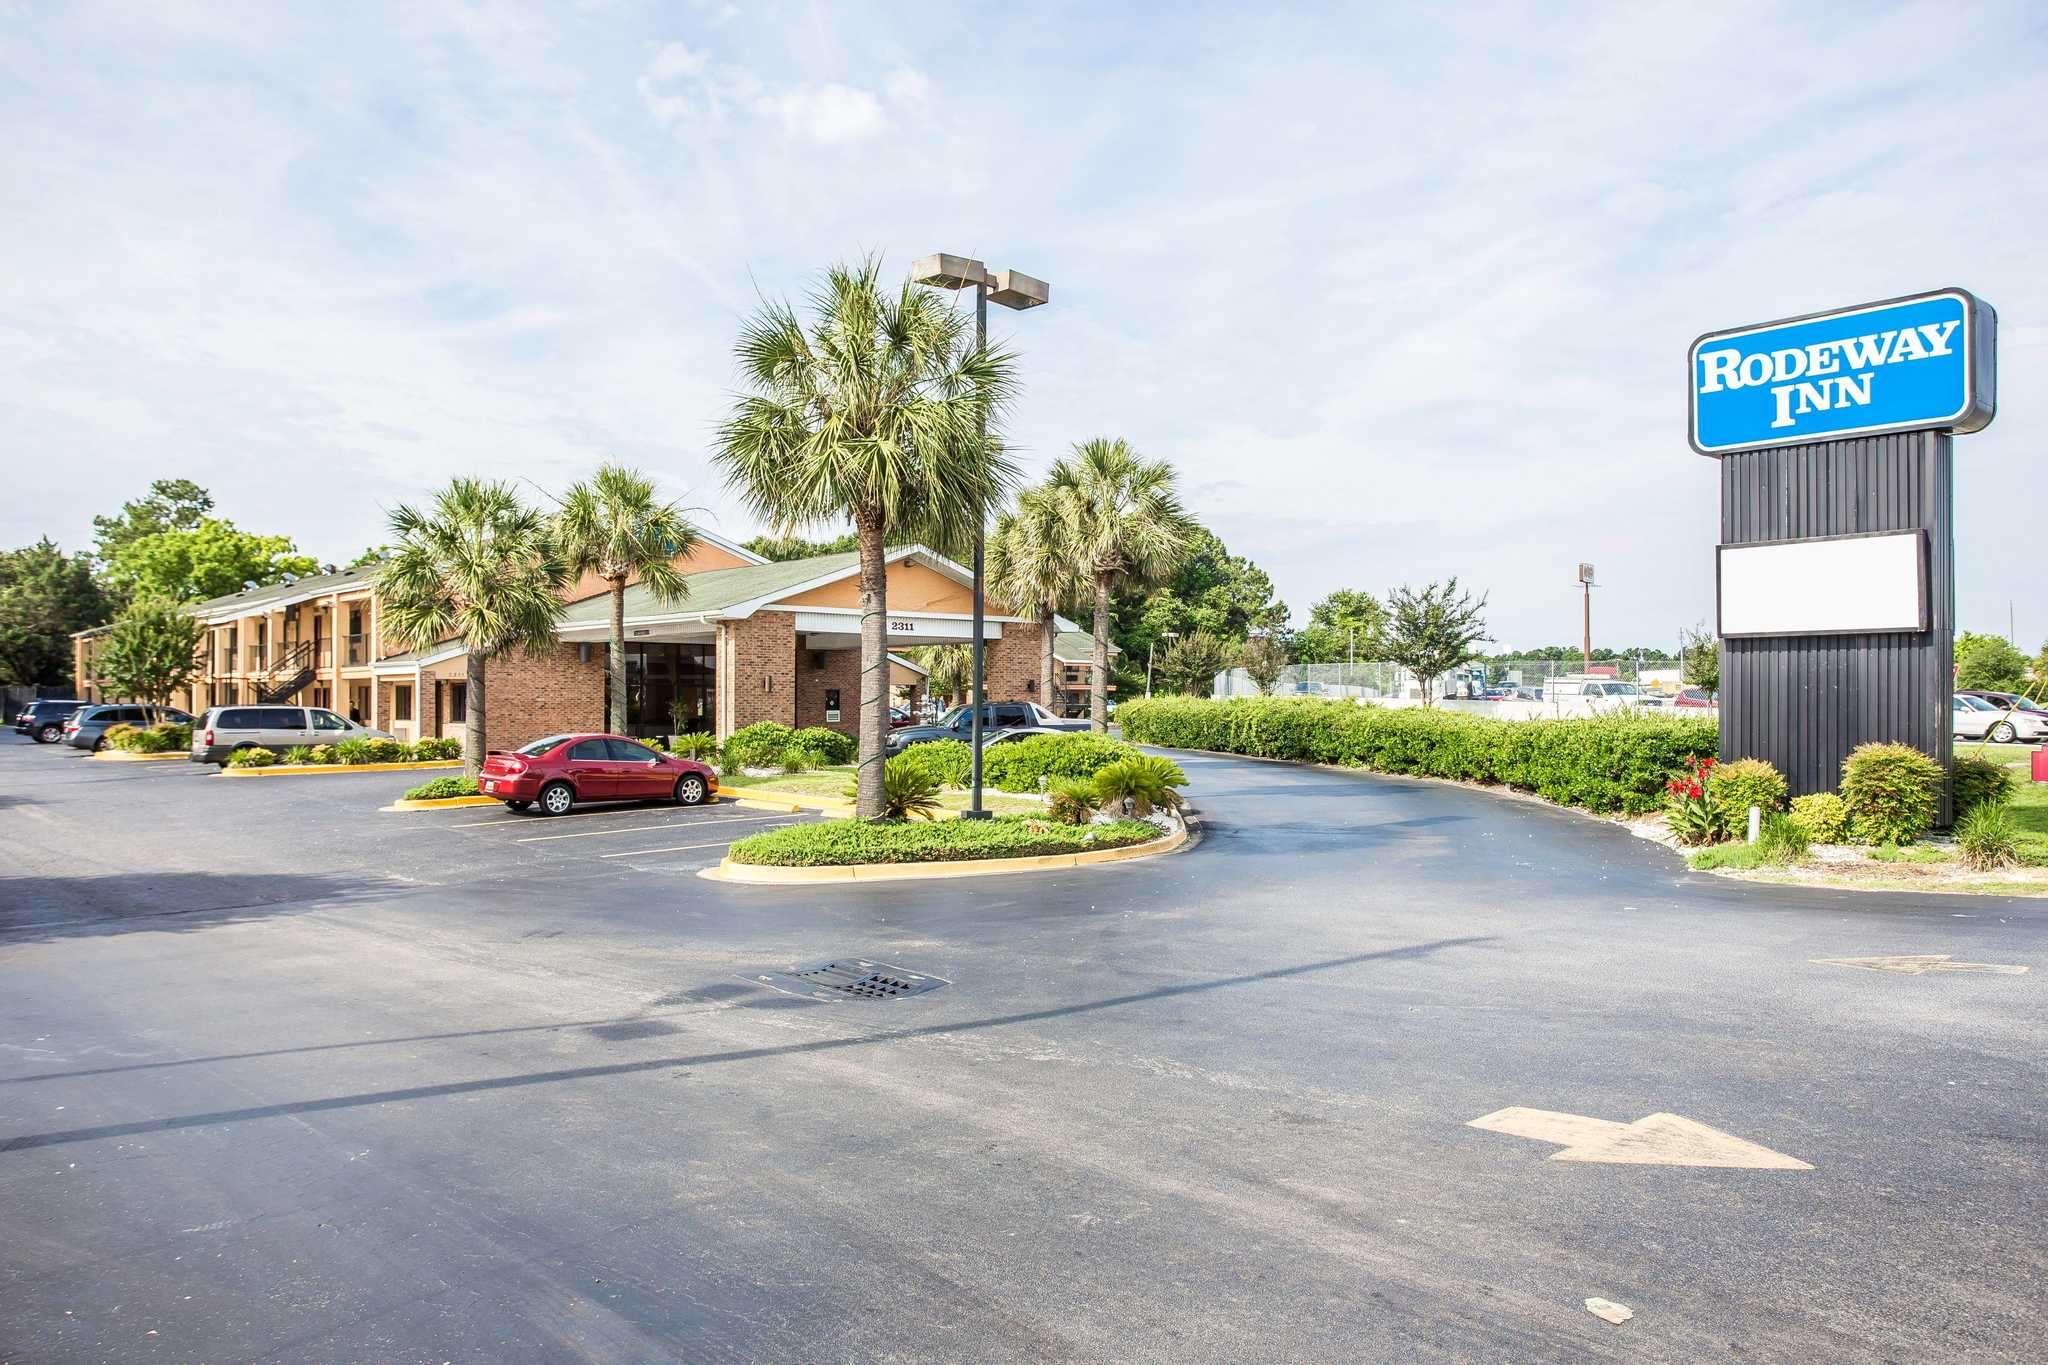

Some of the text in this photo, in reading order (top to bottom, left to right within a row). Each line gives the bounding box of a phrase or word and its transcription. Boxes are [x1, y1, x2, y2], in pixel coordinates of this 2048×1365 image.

[1699, 319, 1961, 394] RODEWAY
[1770, 372, 1875, 429] INN
[891, 621, 914, 631] 2311
